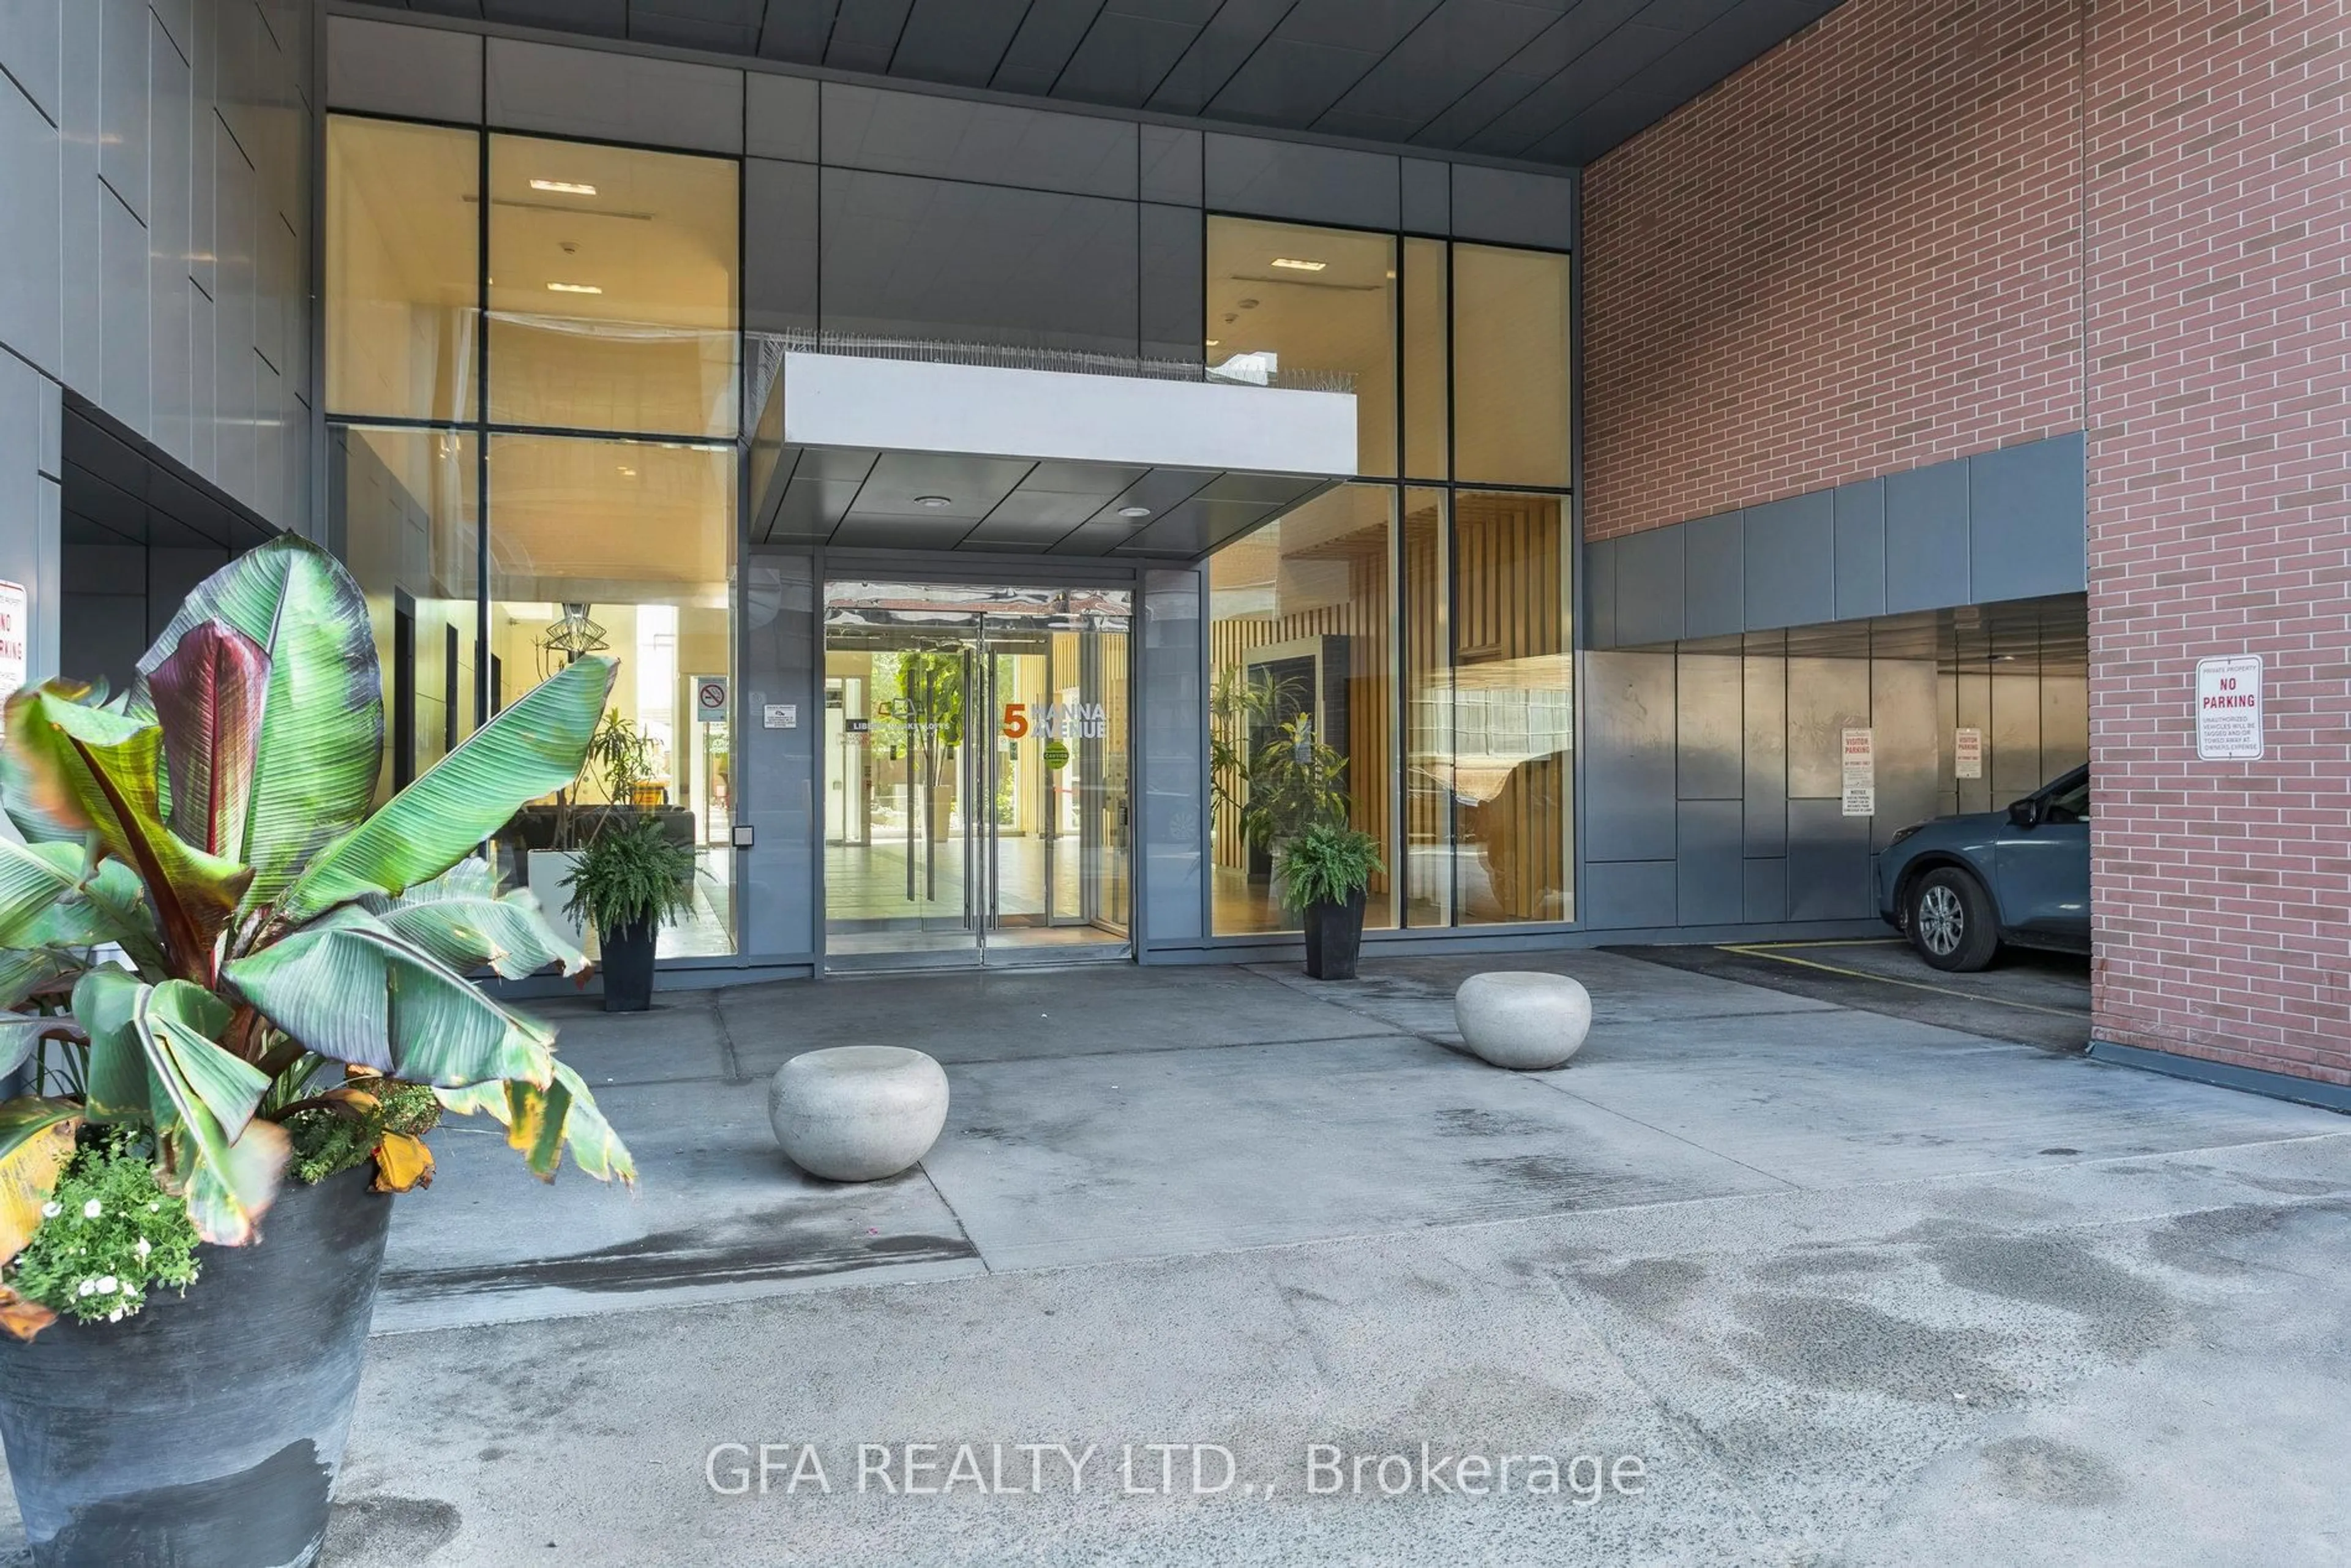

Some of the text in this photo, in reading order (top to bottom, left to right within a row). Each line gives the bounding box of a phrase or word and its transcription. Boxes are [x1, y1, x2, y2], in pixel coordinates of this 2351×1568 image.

[0, 639, 22, 660] RKING
[2219, 678, 2237, 691] NO
[2203, 694, 2255, 709] PARKING
[1003, 702, 1106, 738] 5 HANNA
[1031, 721, 1106, 738] AVENUE
[1845, 746, 1870, 754] PARKING
